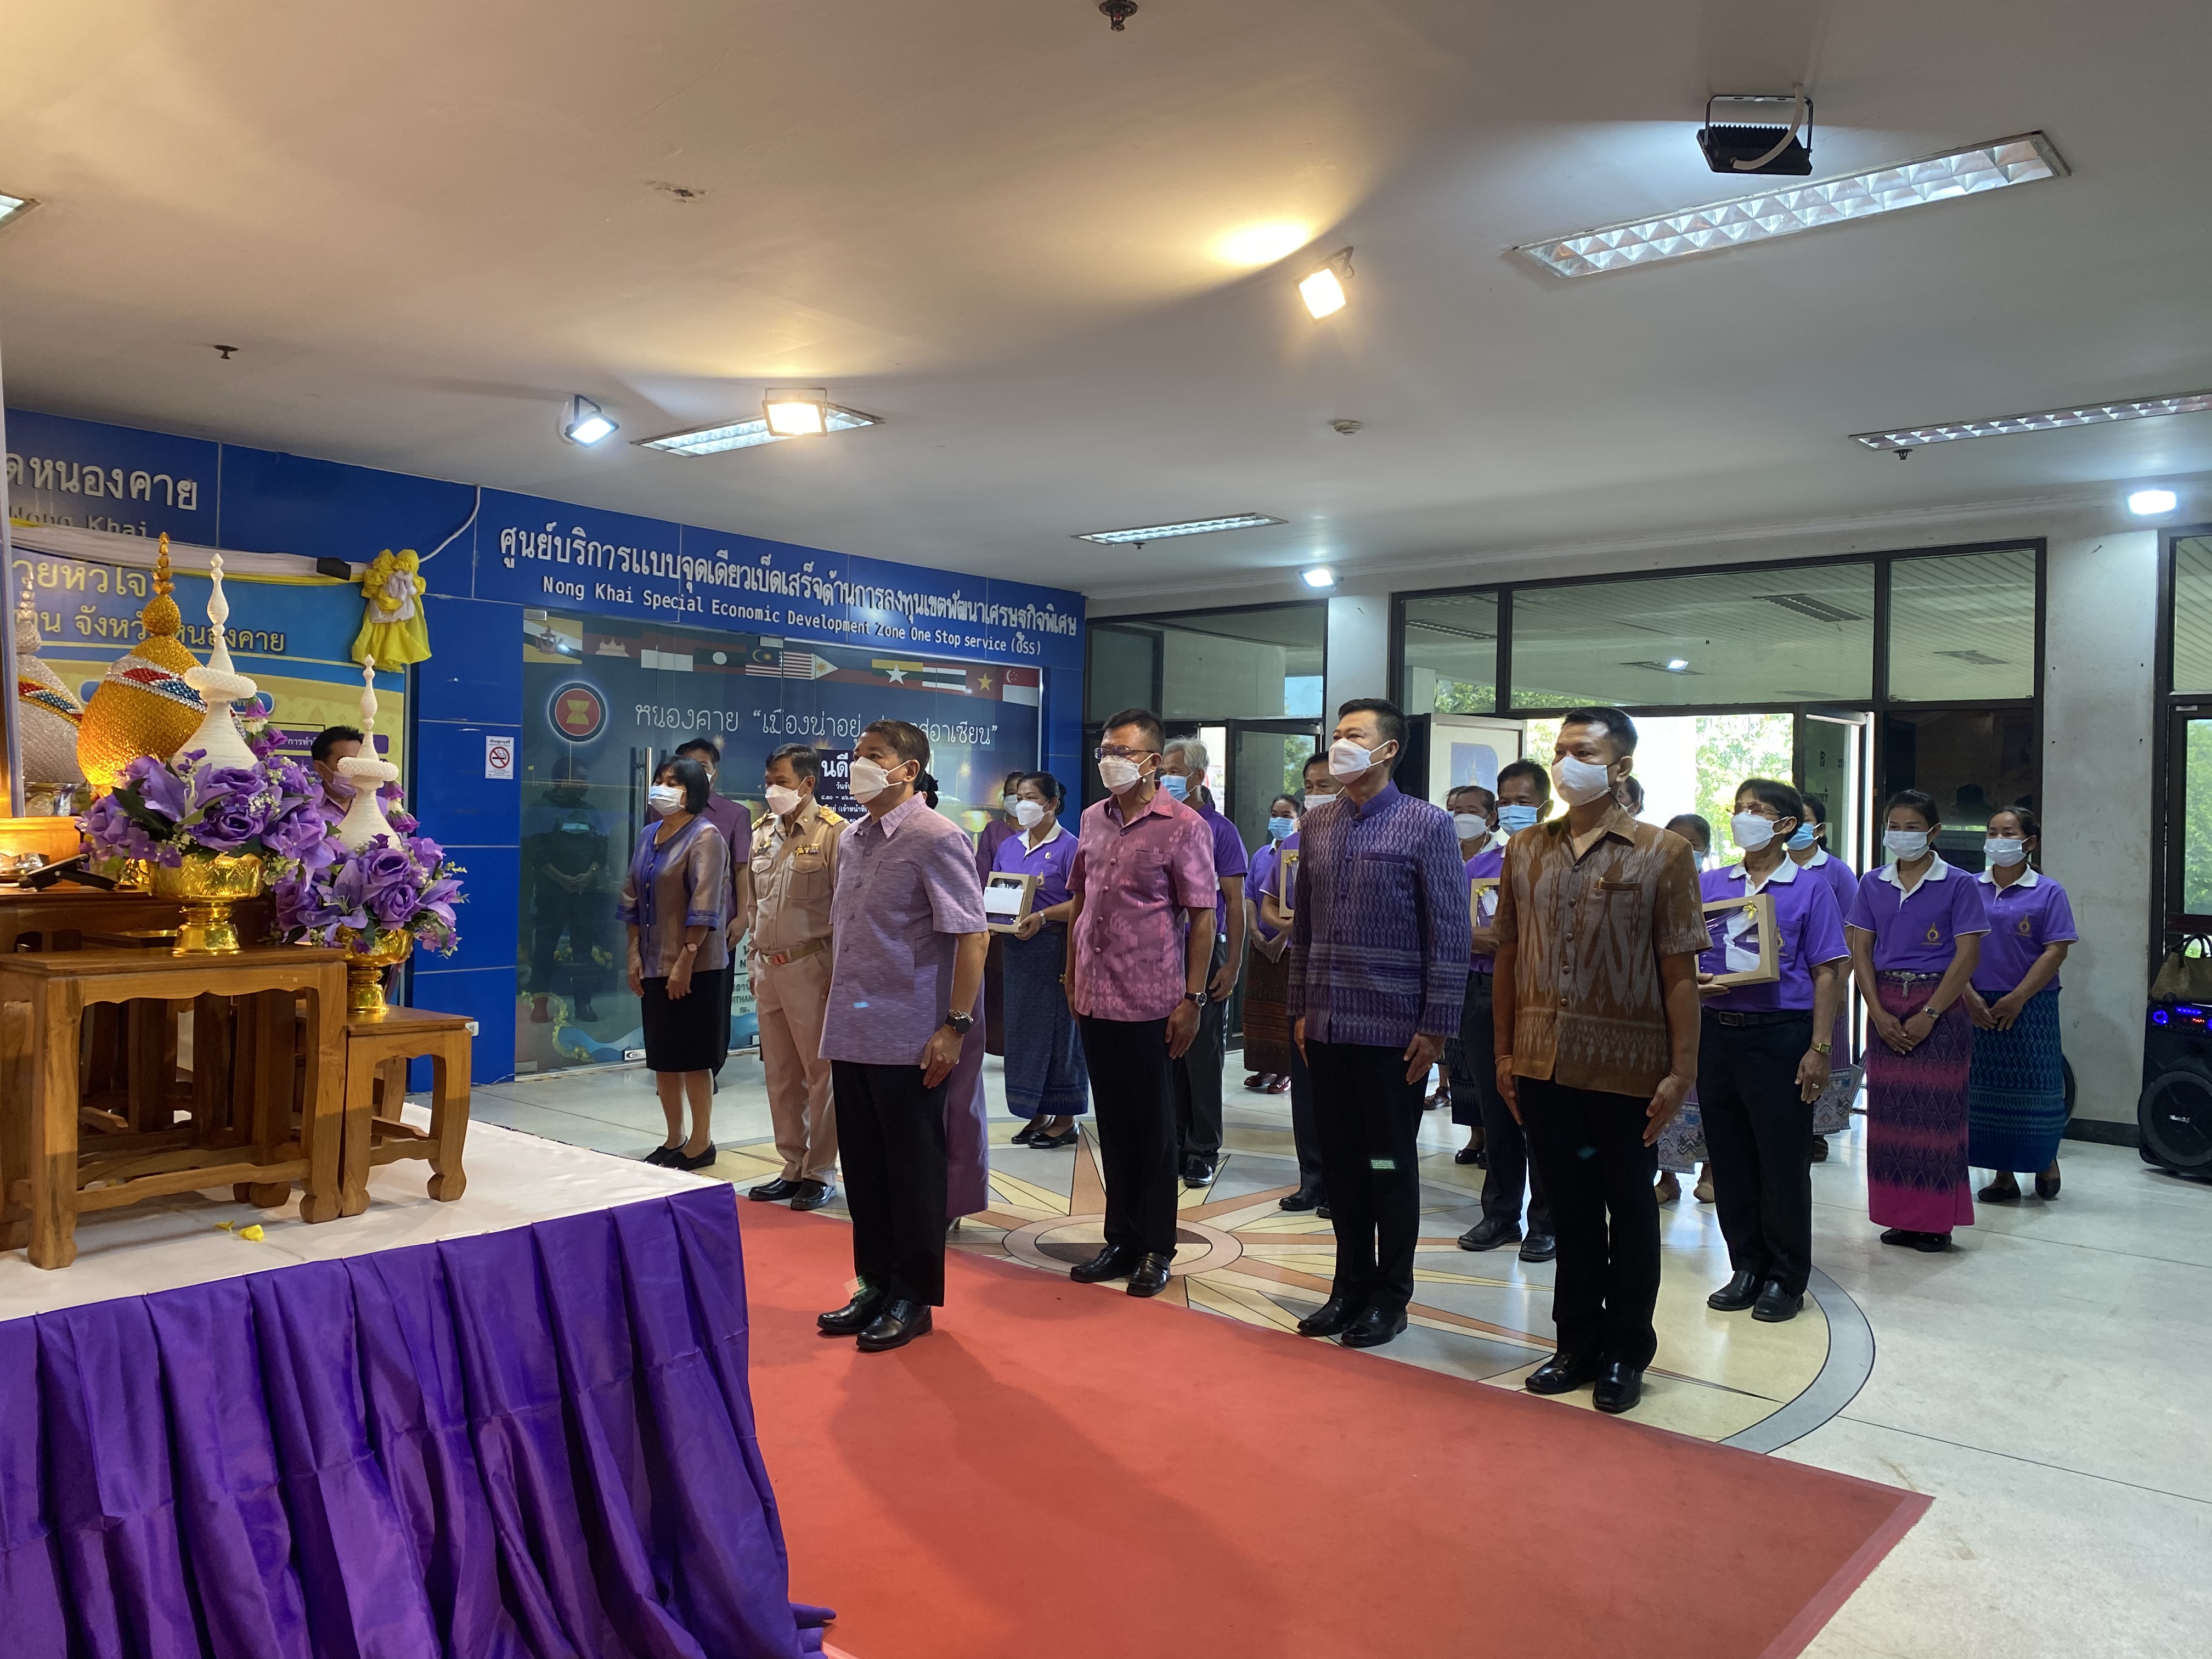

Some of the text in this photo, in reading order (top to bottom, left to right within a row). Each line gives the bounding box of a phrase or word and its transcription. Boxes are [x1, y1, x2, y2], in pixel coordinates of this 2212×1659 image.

[543, 576, 584, 600] Nong
[595, 583, 633, 603] Khai
[643, 590, 703, 613] Special
[712, 599, 780, 623] Economic
[788, 610, 871, 634] Development
[876, 622, 905, 639] Zone
[911, 627, 930, 641] One
[935, 630, 961, 647] Stop
[964, 636, 1006, 651] service
[635, 704, 738, 732] หนองคาย
